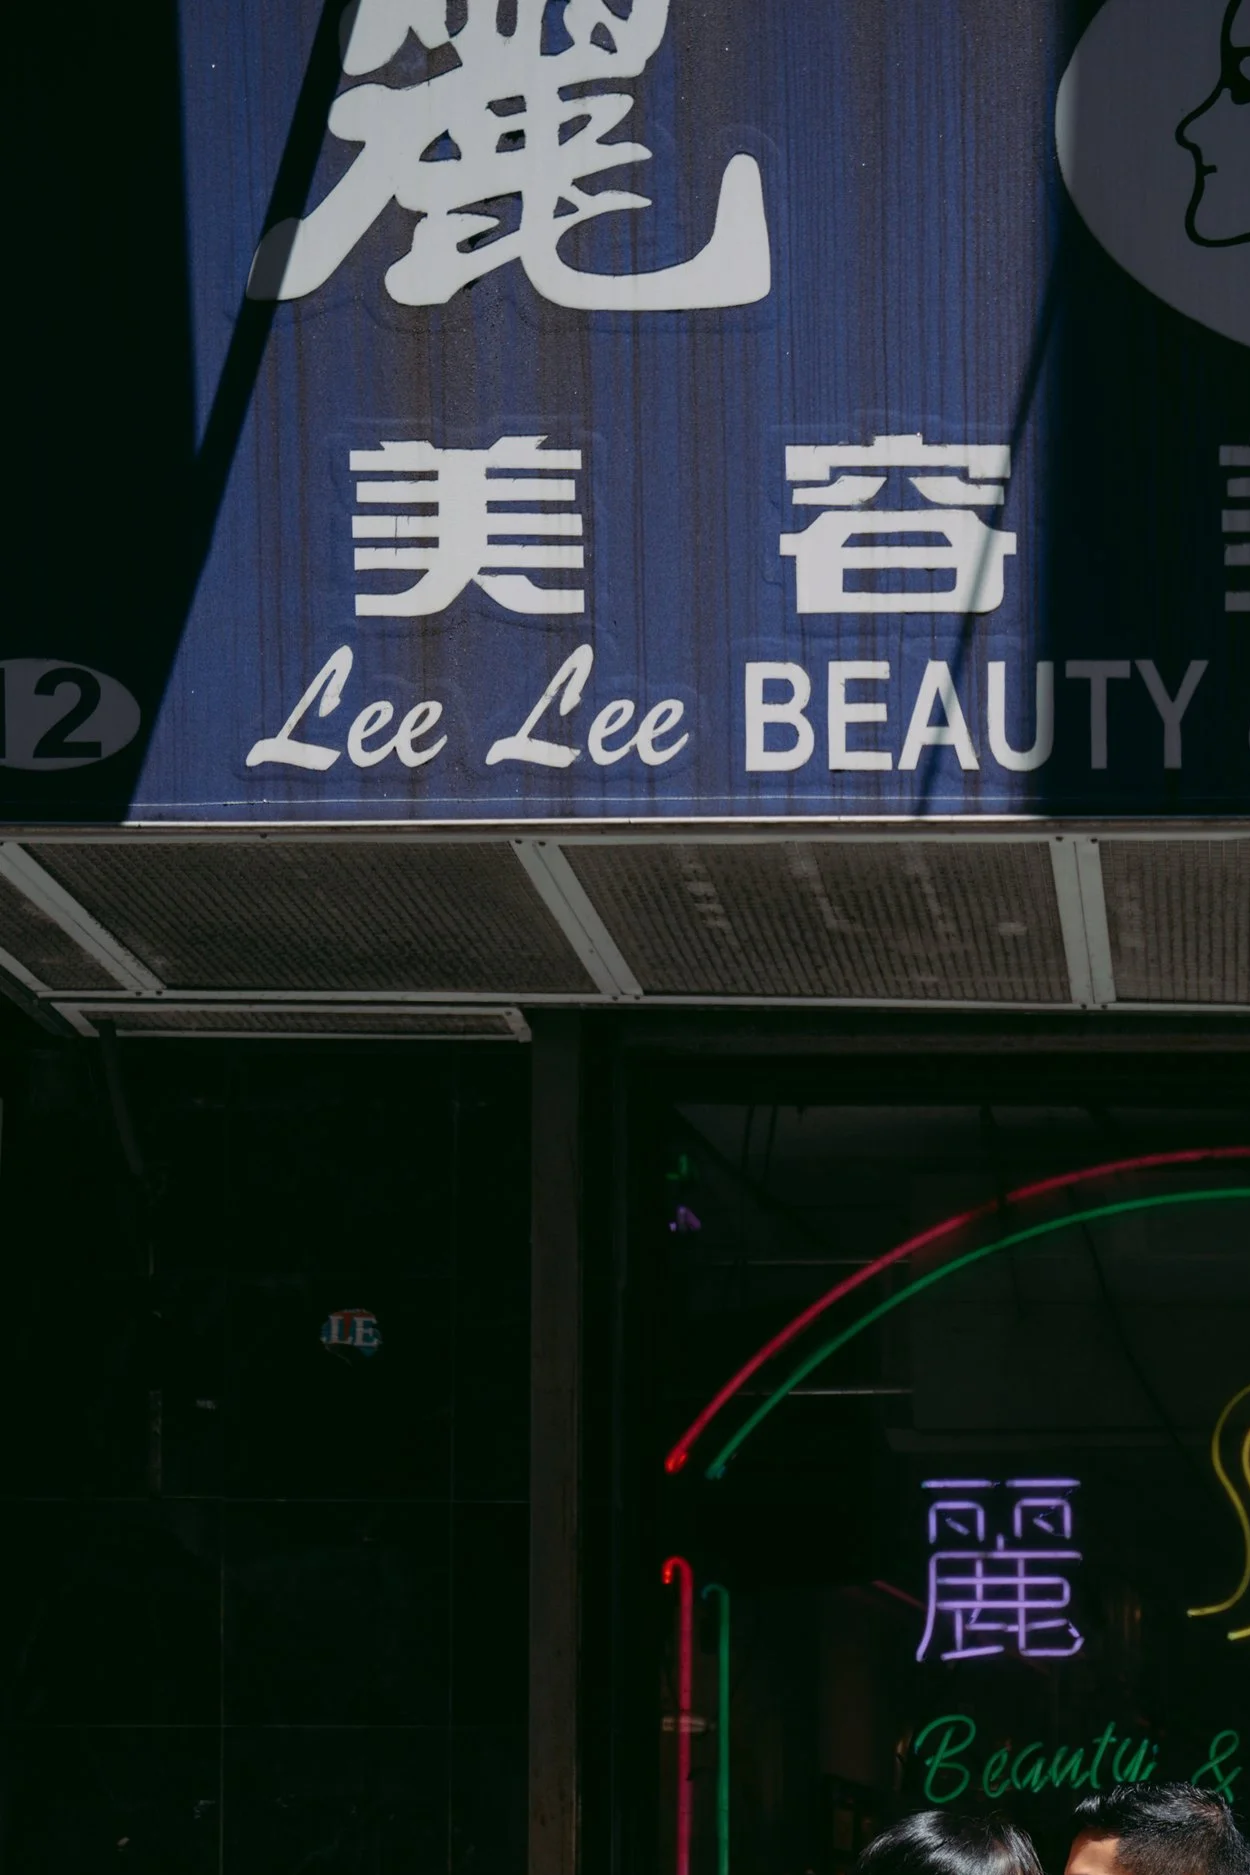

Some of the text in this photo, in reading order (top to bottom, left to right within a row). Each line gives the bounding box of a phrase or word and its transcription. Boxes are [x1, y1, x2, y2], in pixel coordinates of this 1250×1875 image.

[0, 665, 102, 760] 2
[244, 643, 449, 772] Lee
[484, 642, 690, 772] Lee
[744, 658, 1211, 773] BEAUTY
[915, 1476, 1085, 1663] 麗
[913, 1713, 1159, 1804] Beauty
[1190, 1729, 1243, 1804] &
